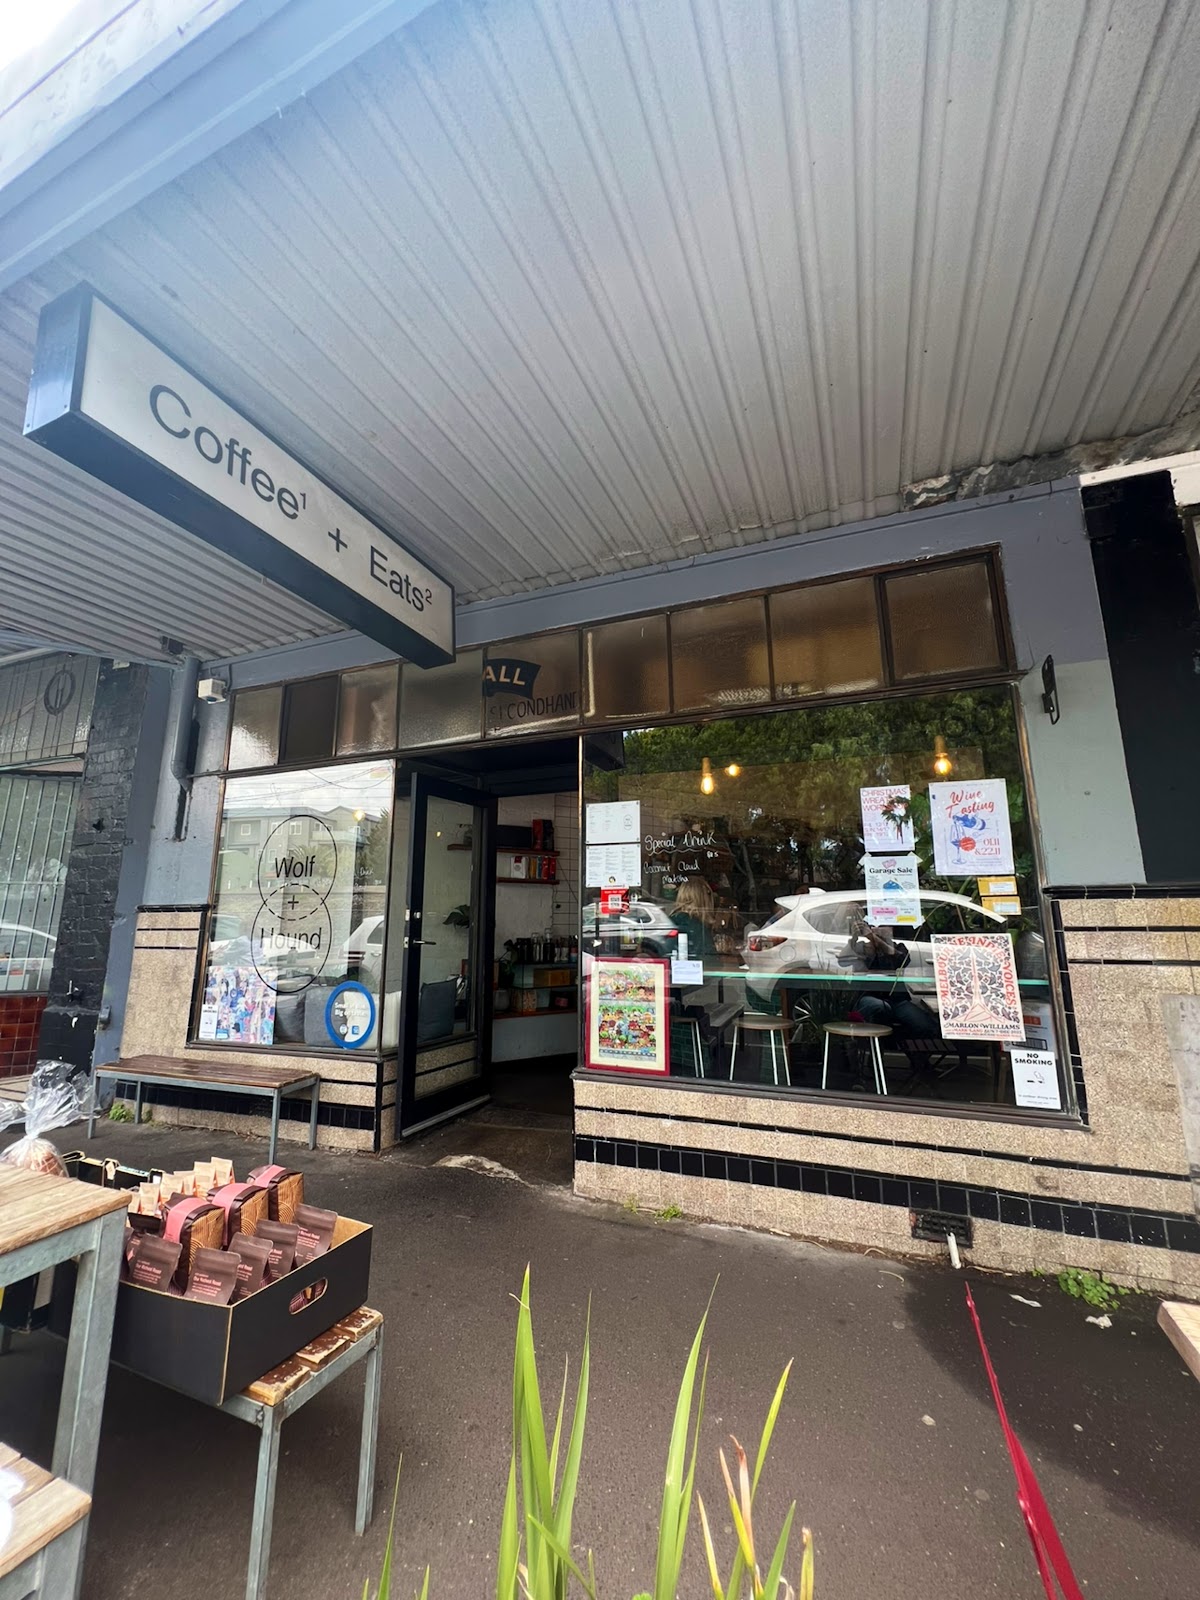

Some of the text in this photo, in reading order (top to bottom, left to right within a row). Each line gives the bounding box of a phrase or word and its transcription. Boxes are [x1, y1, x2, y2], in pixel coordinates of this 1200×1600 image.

[482, 664, 526, 686] ALL
[862, 788, 907, 797] CHRISTMAS
[950, 790, 982, 804] Wine
[945, 801, 995, 819] Tasting
[645, 830, 717, 856] Special Drink
[274, 855, 316, 879] Wolf
[869, 867, 896, 875] Garage
[259, 926, 322, 950] Hound
[1002, 961, 1017, 1006] VOICES
[1014, 1058, 1053, 1066] SMOKING
